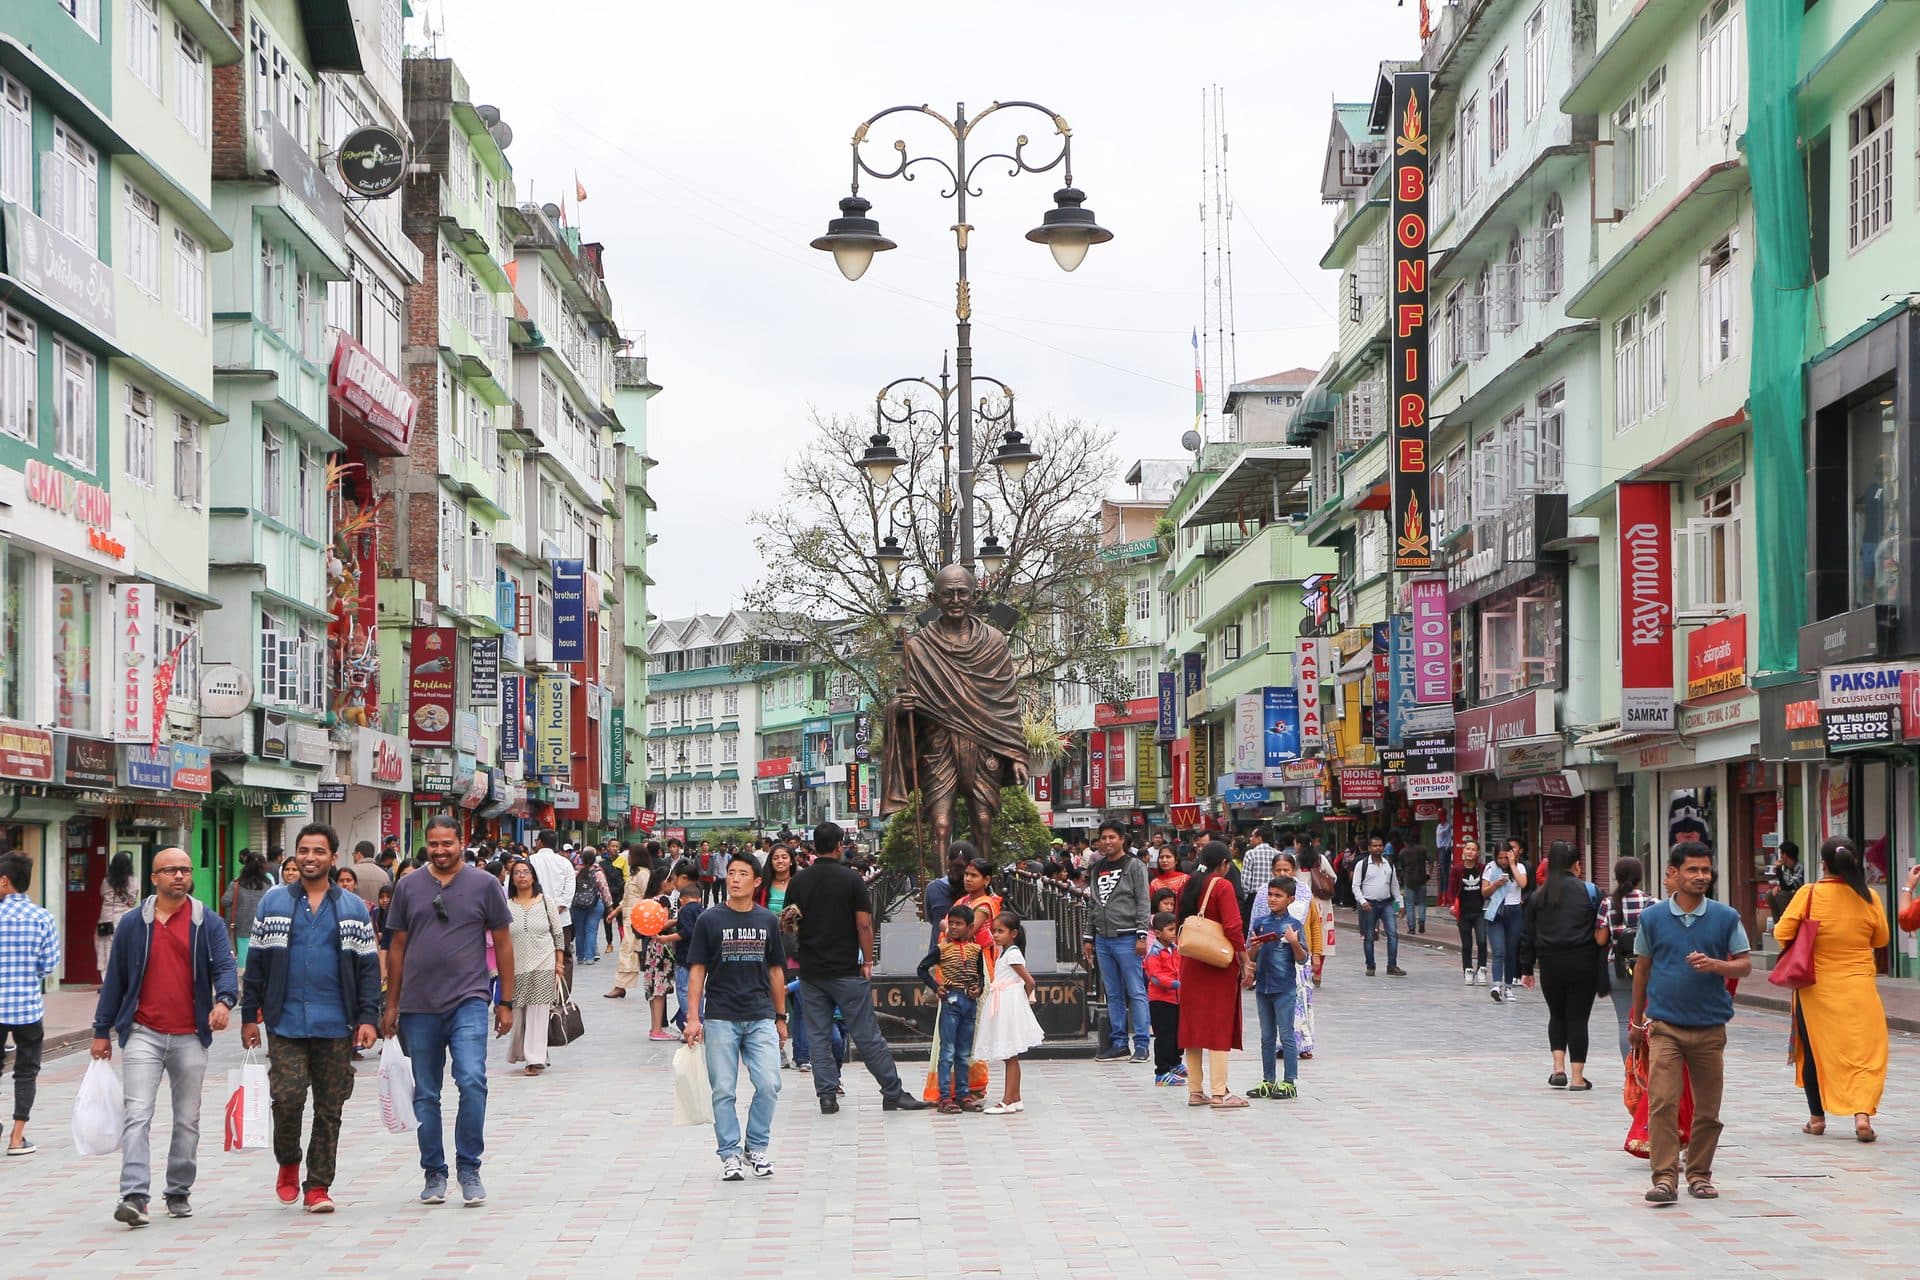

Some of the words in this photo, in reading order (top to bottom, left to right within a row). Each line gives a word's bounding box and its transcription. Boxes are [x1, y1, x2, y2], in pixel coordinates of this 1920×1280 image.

[1396, 165, 1426, 473] BONFIRE
[1264, 396, 1282, 406] THE
[1417, 583, 1443, 598] ALFA
[1624, 523, 1669, 647] Raymond
[125, 587, 140, 651] CHAI
[558, 614, 576, 623] guest
[558, 638, 577, 648] house
[1421, 602, 1447, 696] LODGE
[1301, 642, 1320, 736] PARIVAR
[125, 668, 140, 731] CHUN
[548, 681, 563, 729] house
[1831, 694, 1873, 704] EXCLUSIVE
[1163, 689, 1172, 725] DZONG
[1627, 708, 1669, 722] SAMRAT
[1847, 713, 1864, 723] PASS
[1865, 711, 1888, 721] PHOTO
[505, 713, 515, 749] SWEETS
[1827, 721, 1888, 734] XEROX
[548, 738, 563, 765] roll
[613, 726, 623, 777] WOODLAND
[1383, 751, 1405, 760] CHINA
[1406, 748, 1424, 756] FAMILY
[1424, 747, 1456, 755] RESTAURANT
[1388, 760, 1405, 769] GIFT
[1427, 762, 1438, 770] BAR
[1092, 763, 1100, 790] kotak
[1195, 752, 1206, 797] GOLDEN
[1343, 770, 1381, 779] MONEY
[1409, 778, 1431, 786] CHINA
[1431, 775, 1454, 784] BAZAR
[425, 783, 451, 791] STUDIO
[1415, 785, 1450, 793] GIFTSHOP
[1233, 791, 1262, 800] vivo
[722, 928, 734, 940] MY
[737, 927, 757, 940] ROAD
[759, 928, 767, 940] TO
